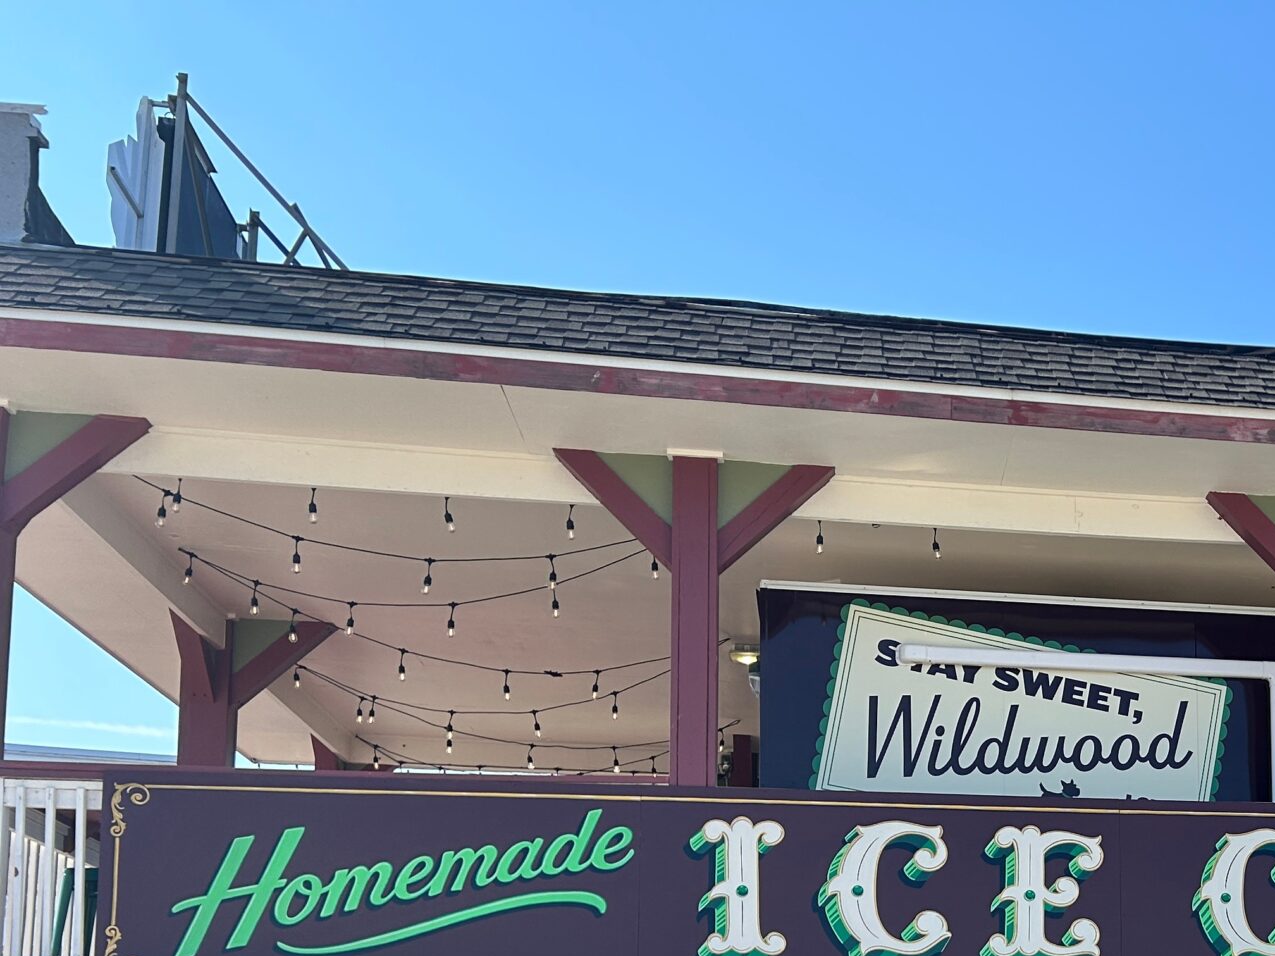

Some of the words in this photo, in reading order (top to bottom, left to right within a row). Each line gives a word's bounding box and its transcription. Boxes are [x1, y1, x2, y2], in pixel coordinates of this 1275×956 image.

[875, 639, 982, 684] SAY
[992, 668, 1143, 725] SWEET,
[867, 694, 1193, 779] Wildwood
